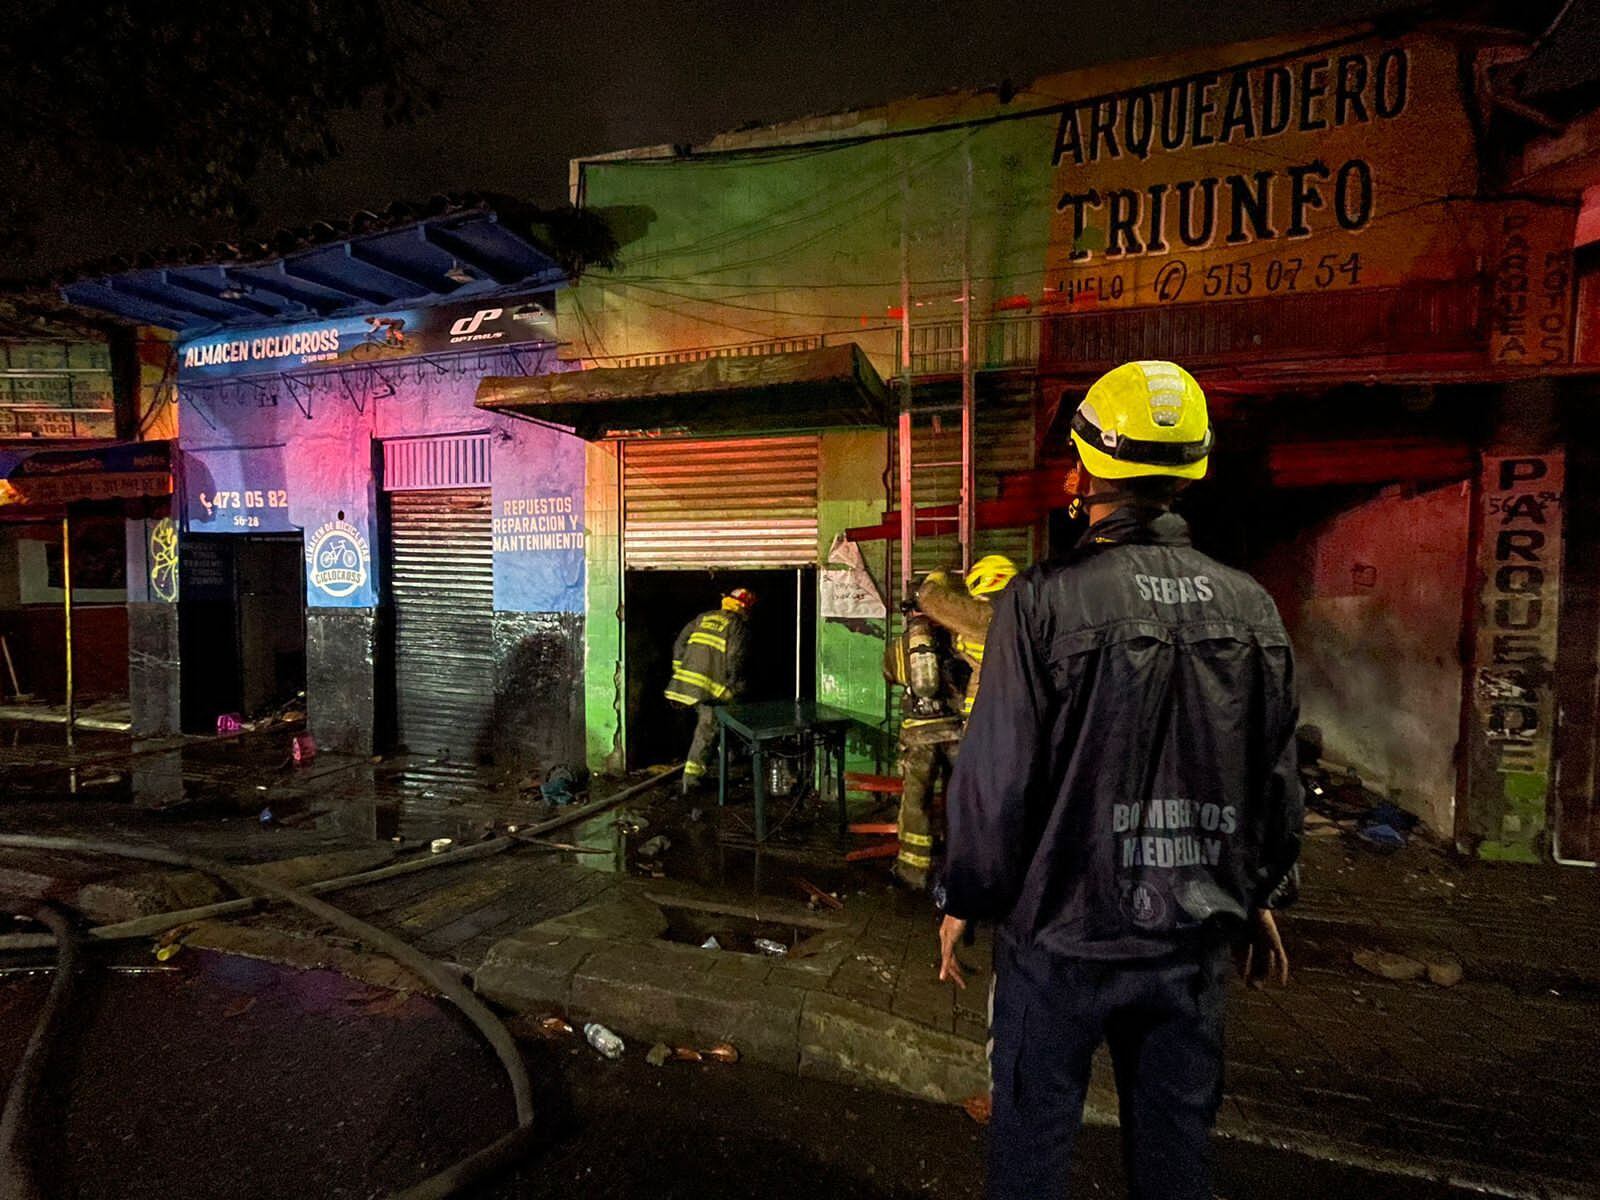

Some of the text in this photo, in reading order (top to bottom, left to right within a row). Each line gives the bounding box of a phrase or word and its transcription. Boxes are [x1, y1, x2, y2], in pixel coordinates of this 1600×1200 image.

[1051, 48, 1409, 167] ARQUEADERO
[1056, 158, 1376, 263] TRIUNFO
[1202, 261, 1252, 298] 513
[1266, 257, 1303, 293] 07
[1315, 252, 1362, 288] 54
[184, 339, 249, 368] ALMACEN
[251, 328, 340, 360] CICLOCROSS
[212, 489, 289, 509] 473 05 82
[503, 496, 573, 516] REPUESTOS
[493, 514, 579, 534] REPARACION Y
[493, 532, 584, 552] MANTENIMIENTO
[314, 570, 362, 585] CICLOCROSS
[1135, 573, 1214, 605] SEBAS
